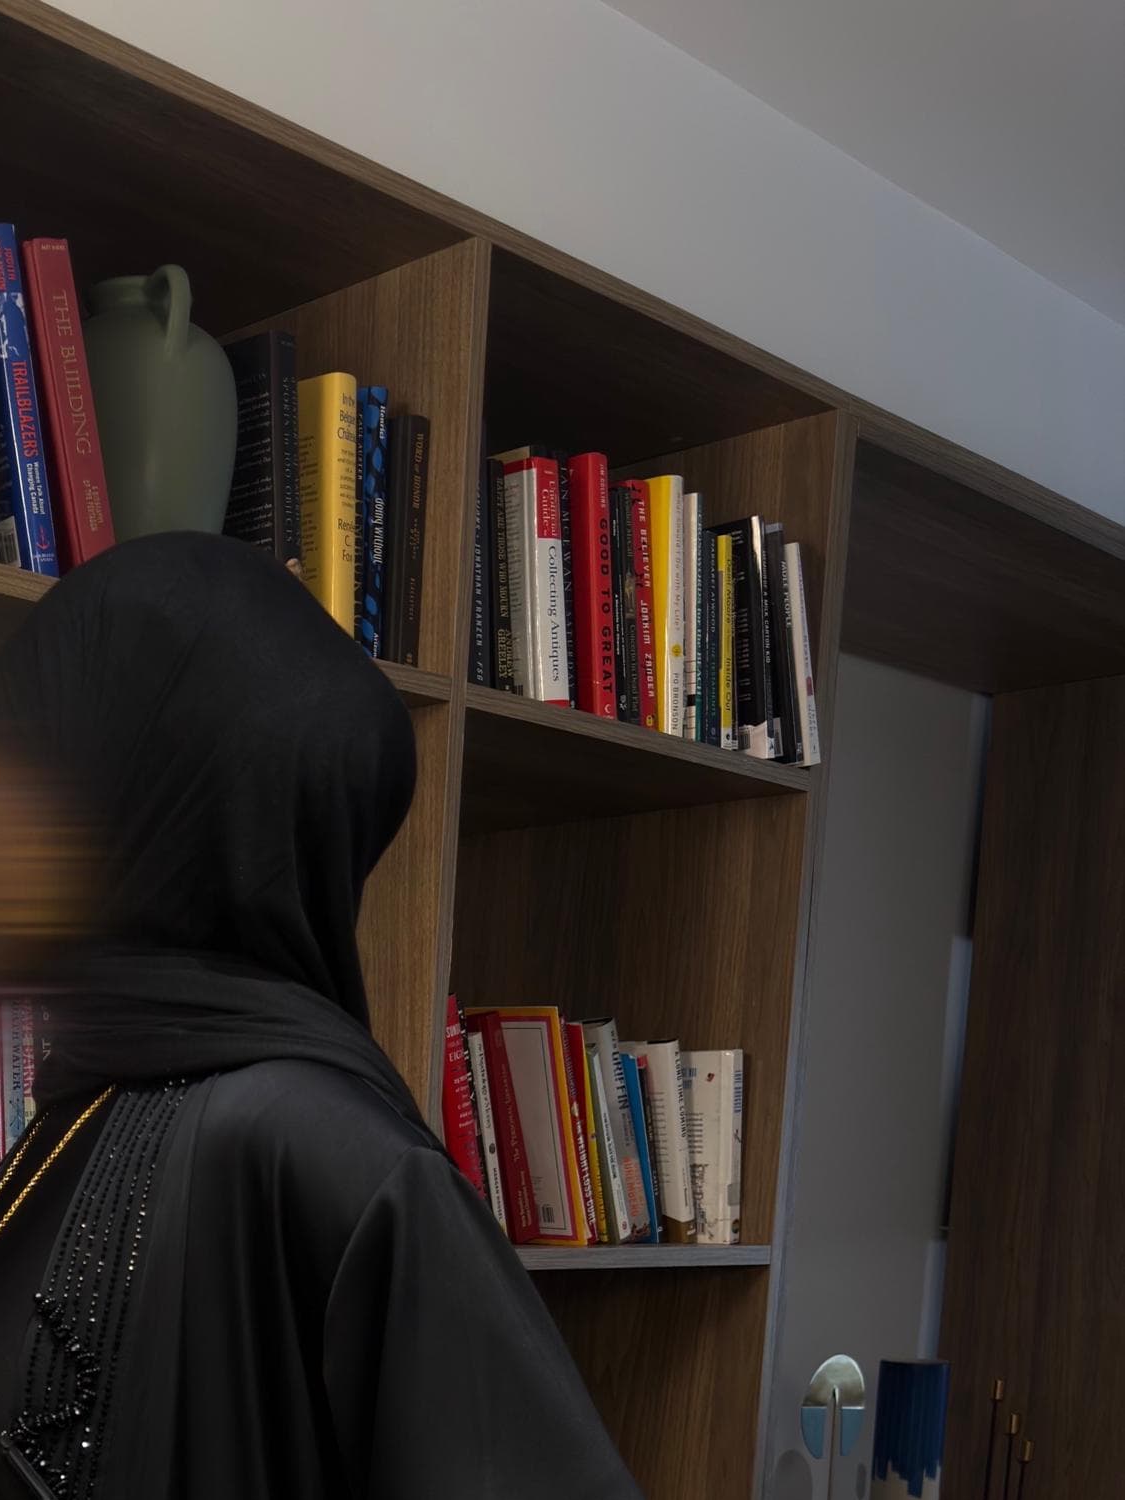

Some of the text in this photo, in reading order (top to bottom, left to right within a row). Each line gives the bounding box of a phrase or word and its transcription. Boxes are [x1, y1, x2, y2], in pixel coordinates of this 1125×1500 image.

[53, 289, 92, 455] THE BUILDING
[12, 361, 39, 458] TRAILBLAZERS
[560, 467, 570, 500] IAN
[637, 499, 646, 523] THE
[372, 497, 386, 564] doing without
[639, 527, 651, 589] BELIEVER
[474, 544, 483, 647] JONATHAN FRANZEN
[548, 545, 561, 682] Collecting Antiques
[600, 518, 613, 694] GOOD TO GREAT
[497, 628, 507, 679] GREELEY
[12, 1052, 21, 1091] WATER
